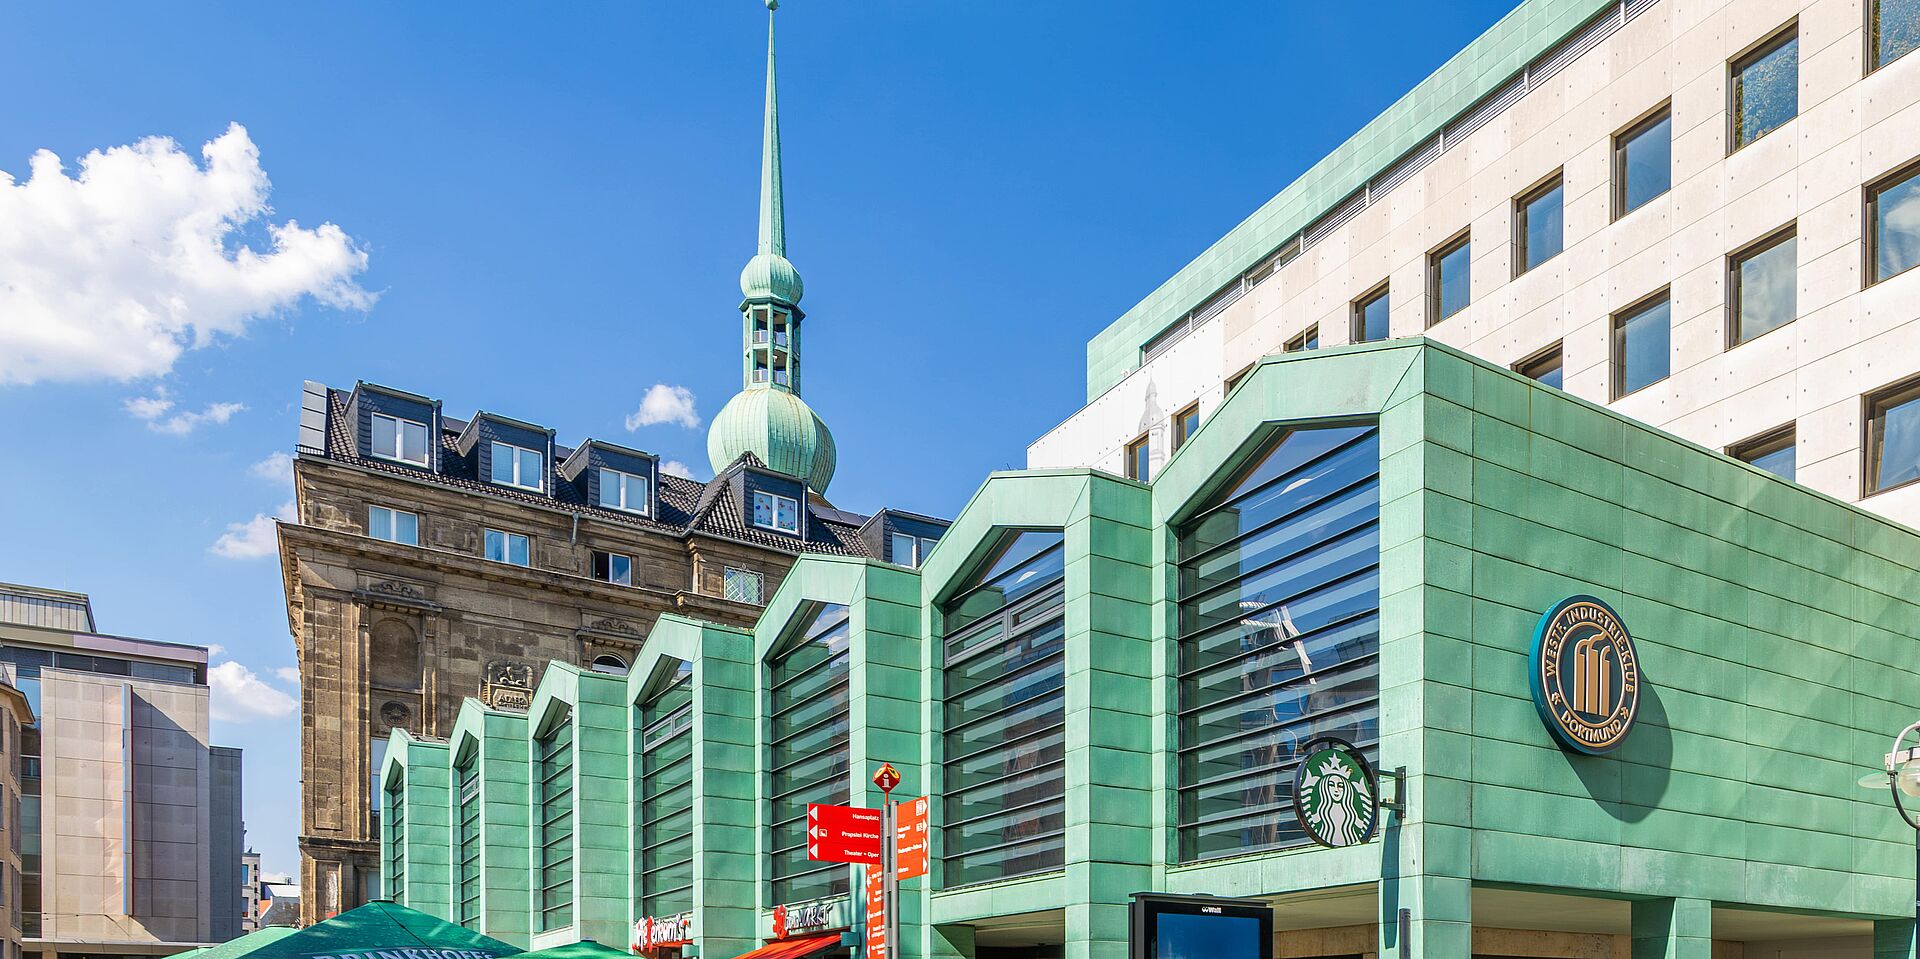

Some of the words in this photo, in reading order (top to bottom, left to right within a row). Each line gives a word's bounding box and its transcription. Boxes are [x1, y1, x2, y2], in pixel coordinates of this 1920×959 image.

[1546, 621, 1567, 677] WESTF.
[1565, 607, 1635, 693] INDUSTRIE-KLUB
[1560, 710, 1622, 743] DORTMUND
[852, 813, 880, 821] Hansaplatz
[843, 849, 862, 857] Theater
